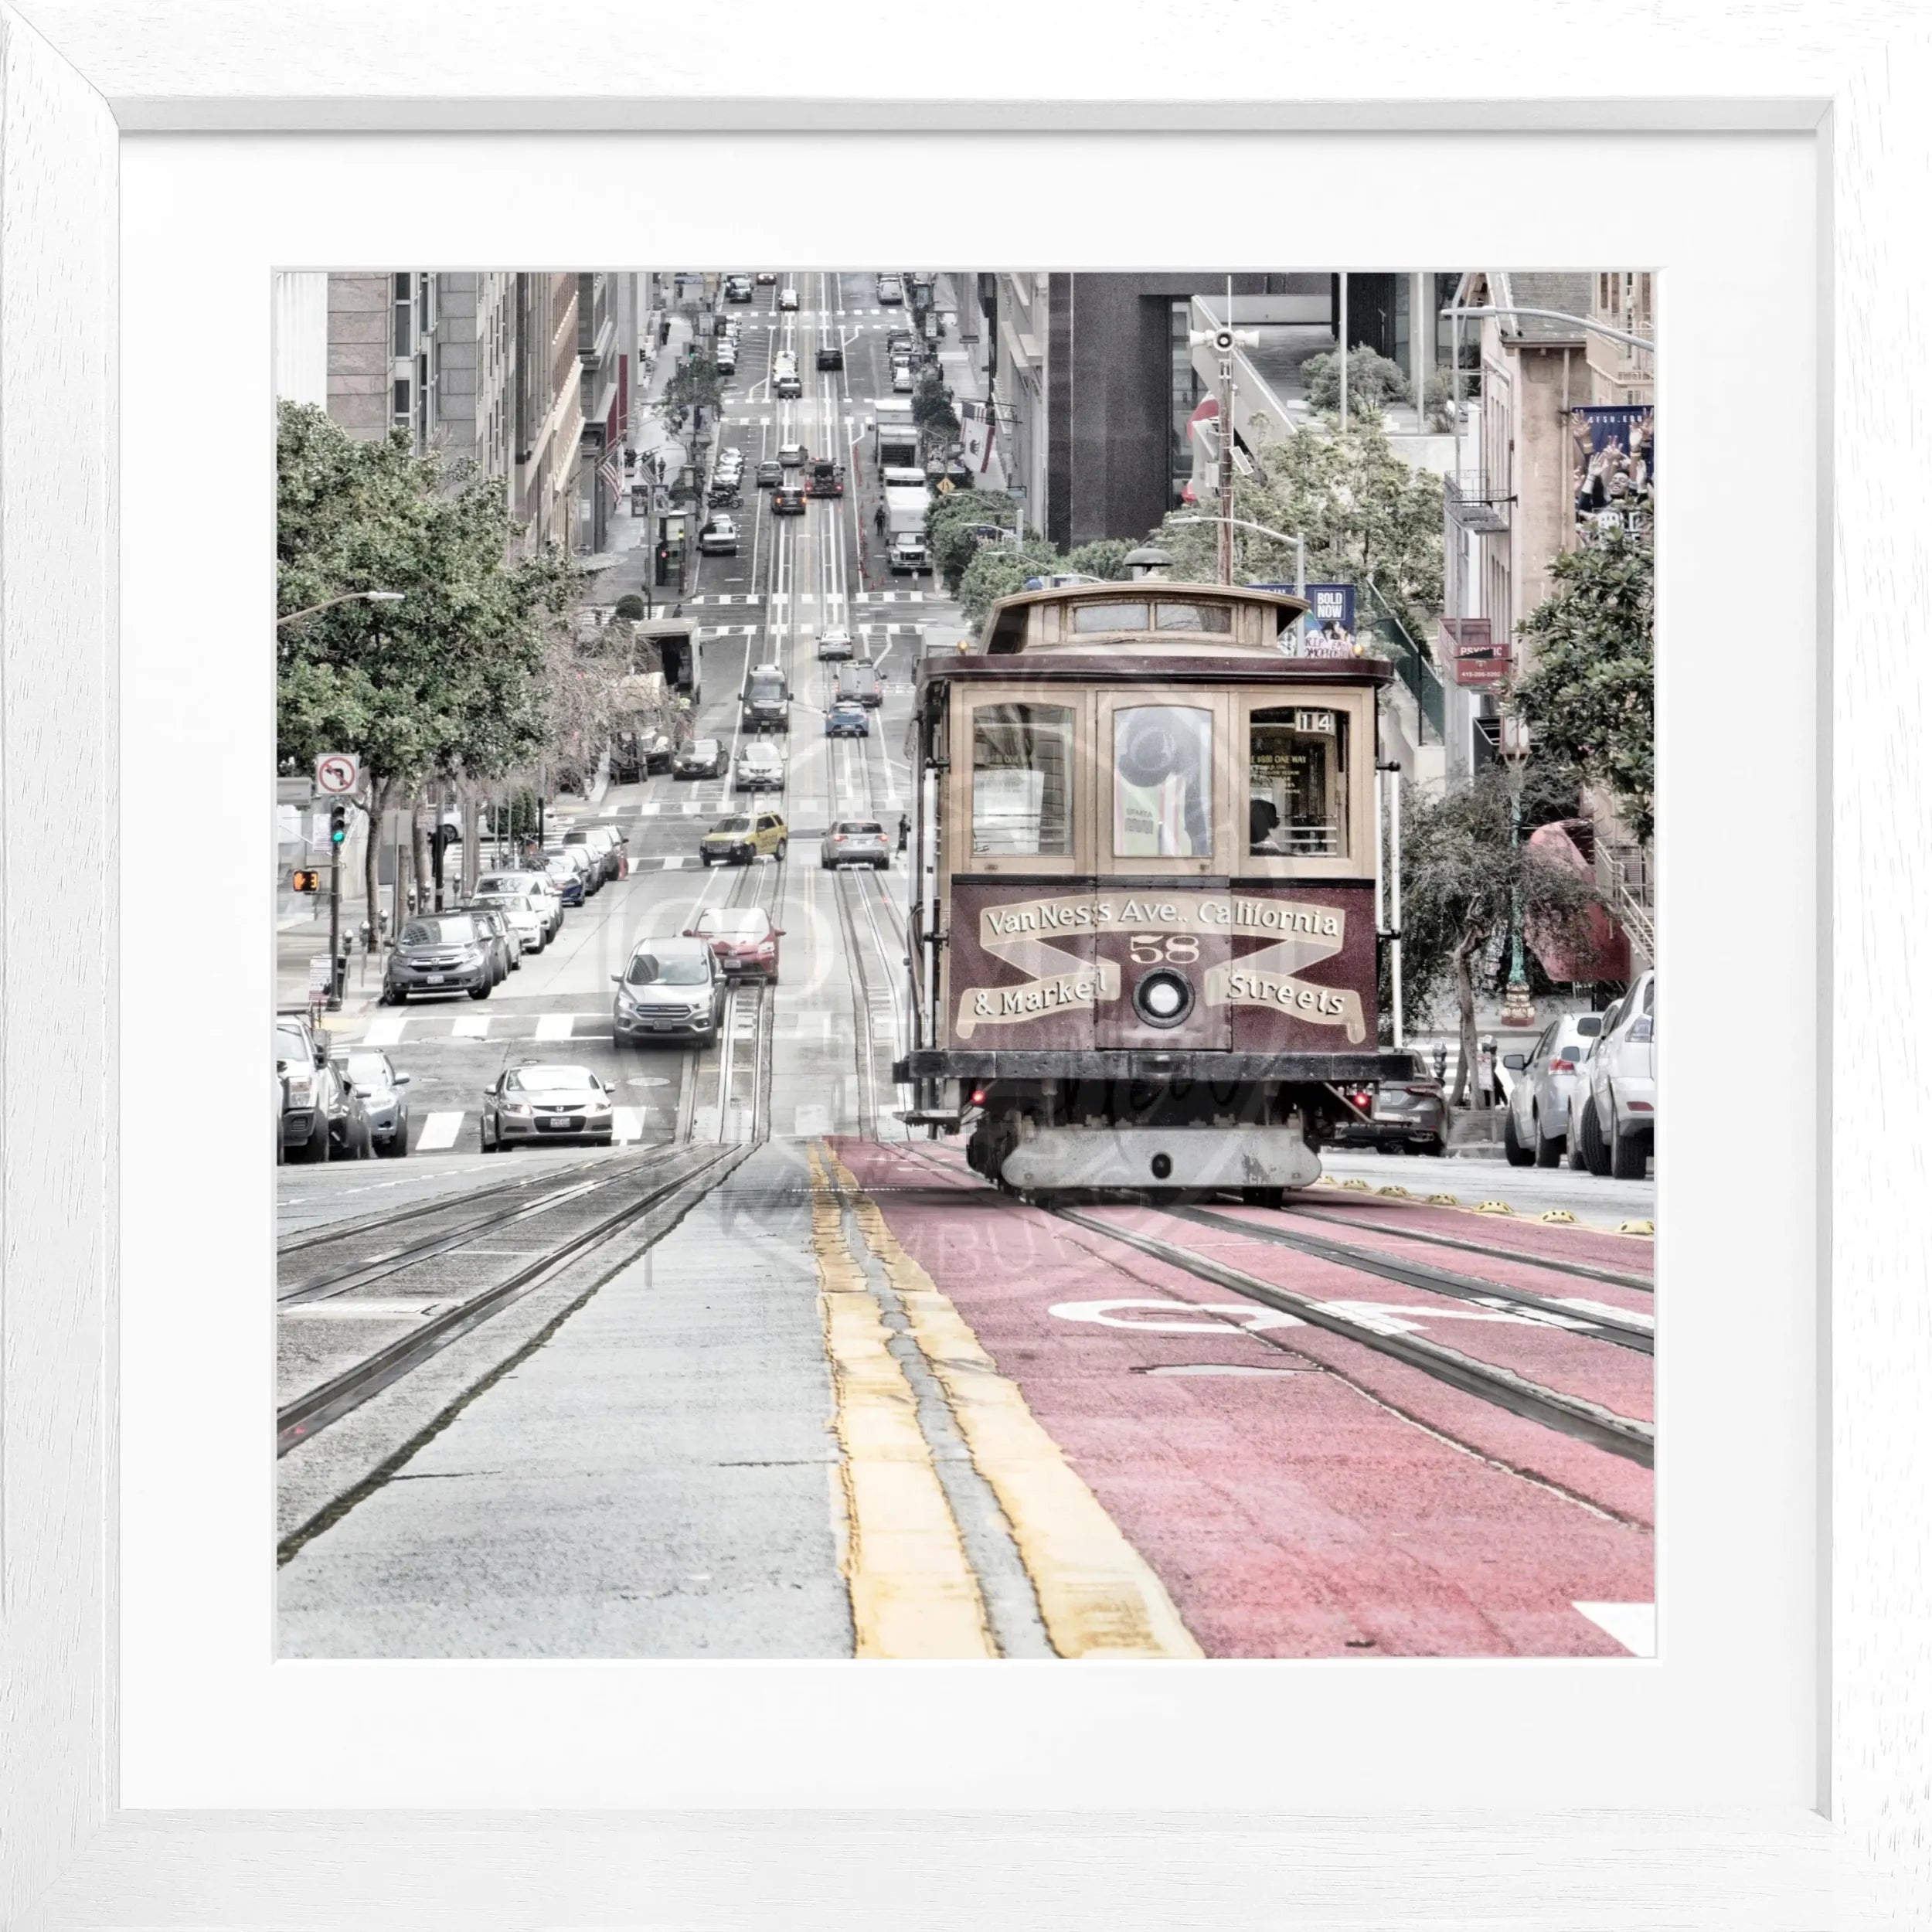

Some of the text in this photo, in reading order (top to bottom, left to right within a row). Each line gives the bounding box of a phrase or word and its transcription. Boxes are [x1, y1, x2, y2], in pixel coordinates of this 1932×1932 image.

[1589, 415, 1643, 423] SFSU.EDU
[1316, 592, 1343, 605] BOLD
[1317, 604, 1342, 618] NOW
[1460, 647, 1503, 656] PSYIC
[1301, 713, 1331, 731] 14
[1291, 755, 1307, 764] WAY
[987, 911, 1036, 936] Van
[1199, 900, 1338, 937] California
[1131, 934, 1199, 964] 58
[974, 968, 1107, 1016] & Market
[1226, 972, 1346, 1016] Streets
